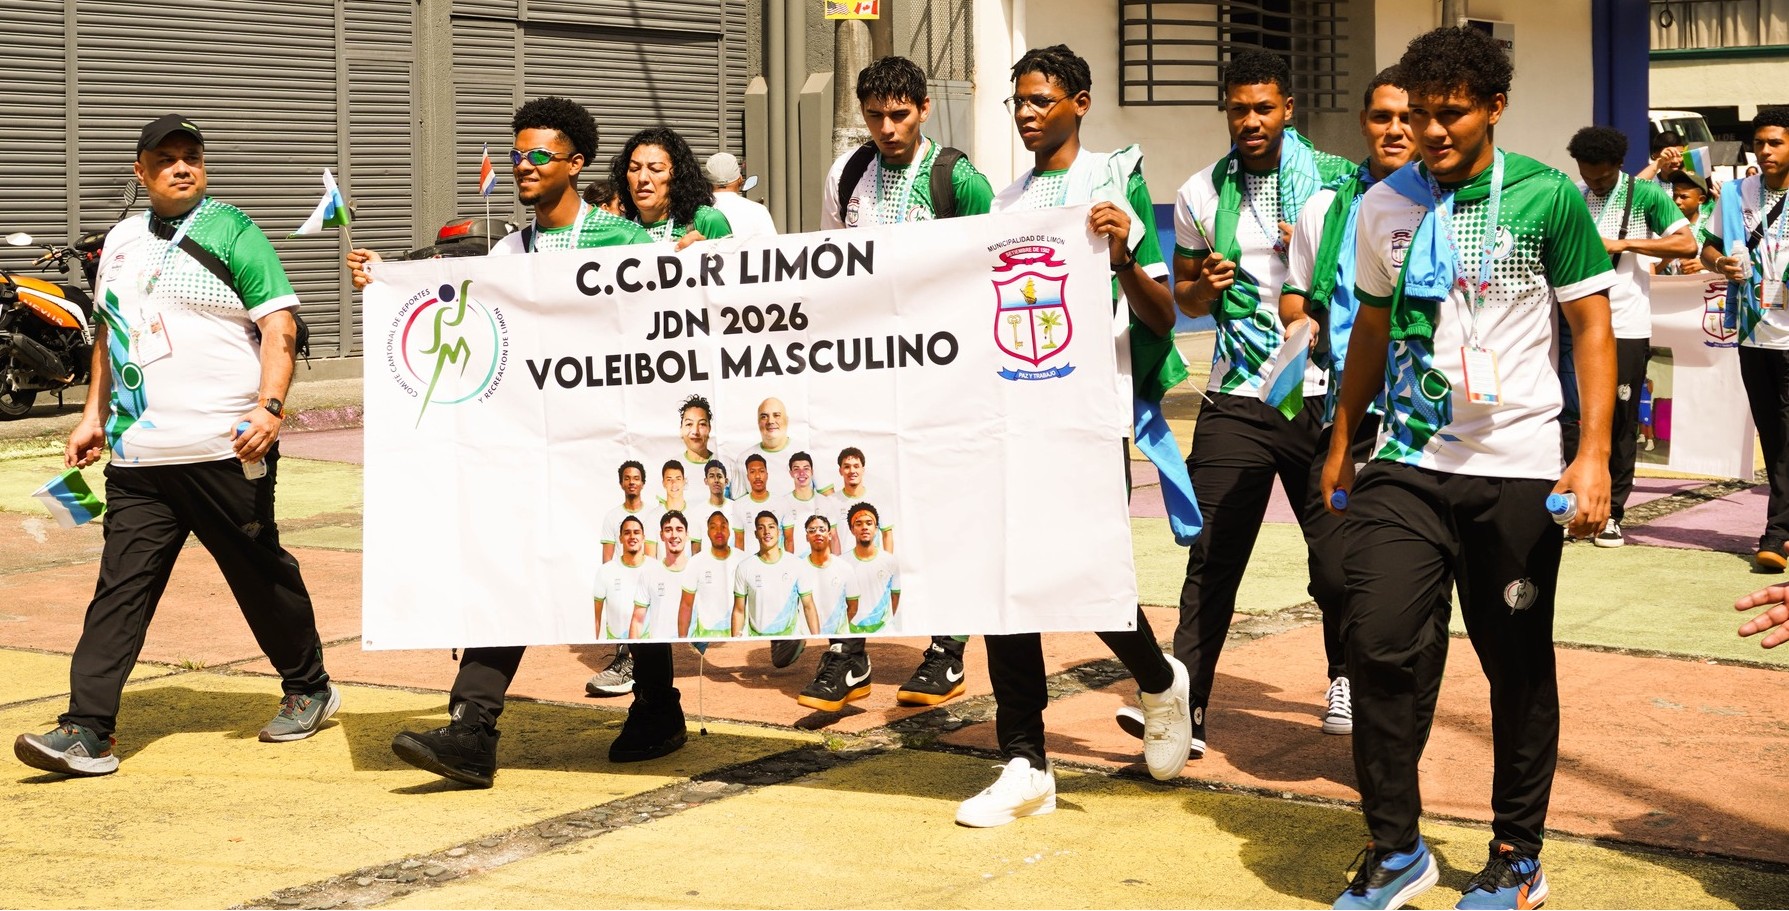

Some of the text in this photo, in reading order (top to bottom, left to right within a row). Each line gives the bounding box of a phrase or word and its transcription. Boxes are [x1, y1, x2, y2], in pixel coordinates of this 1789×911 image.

[576, 237, 875, 297] C.C.D.R LIMÓN
[987, 235, 1035, 252] MUNICIPALIDAD
[386, 329, 398, 373] CANTONAL
[392, 316, 401, 328] DE
[398, 288, 431, 317] DEPORTES
[646, 302, 809, 341] JDN 2026
[477, 396, 484, 404] Y
[502, 336, 509, 347] DE
[525, 330, 959, 390] VOLEIBOL MASCULINO
[1034, 370, 1055, 378] TRABAJO
